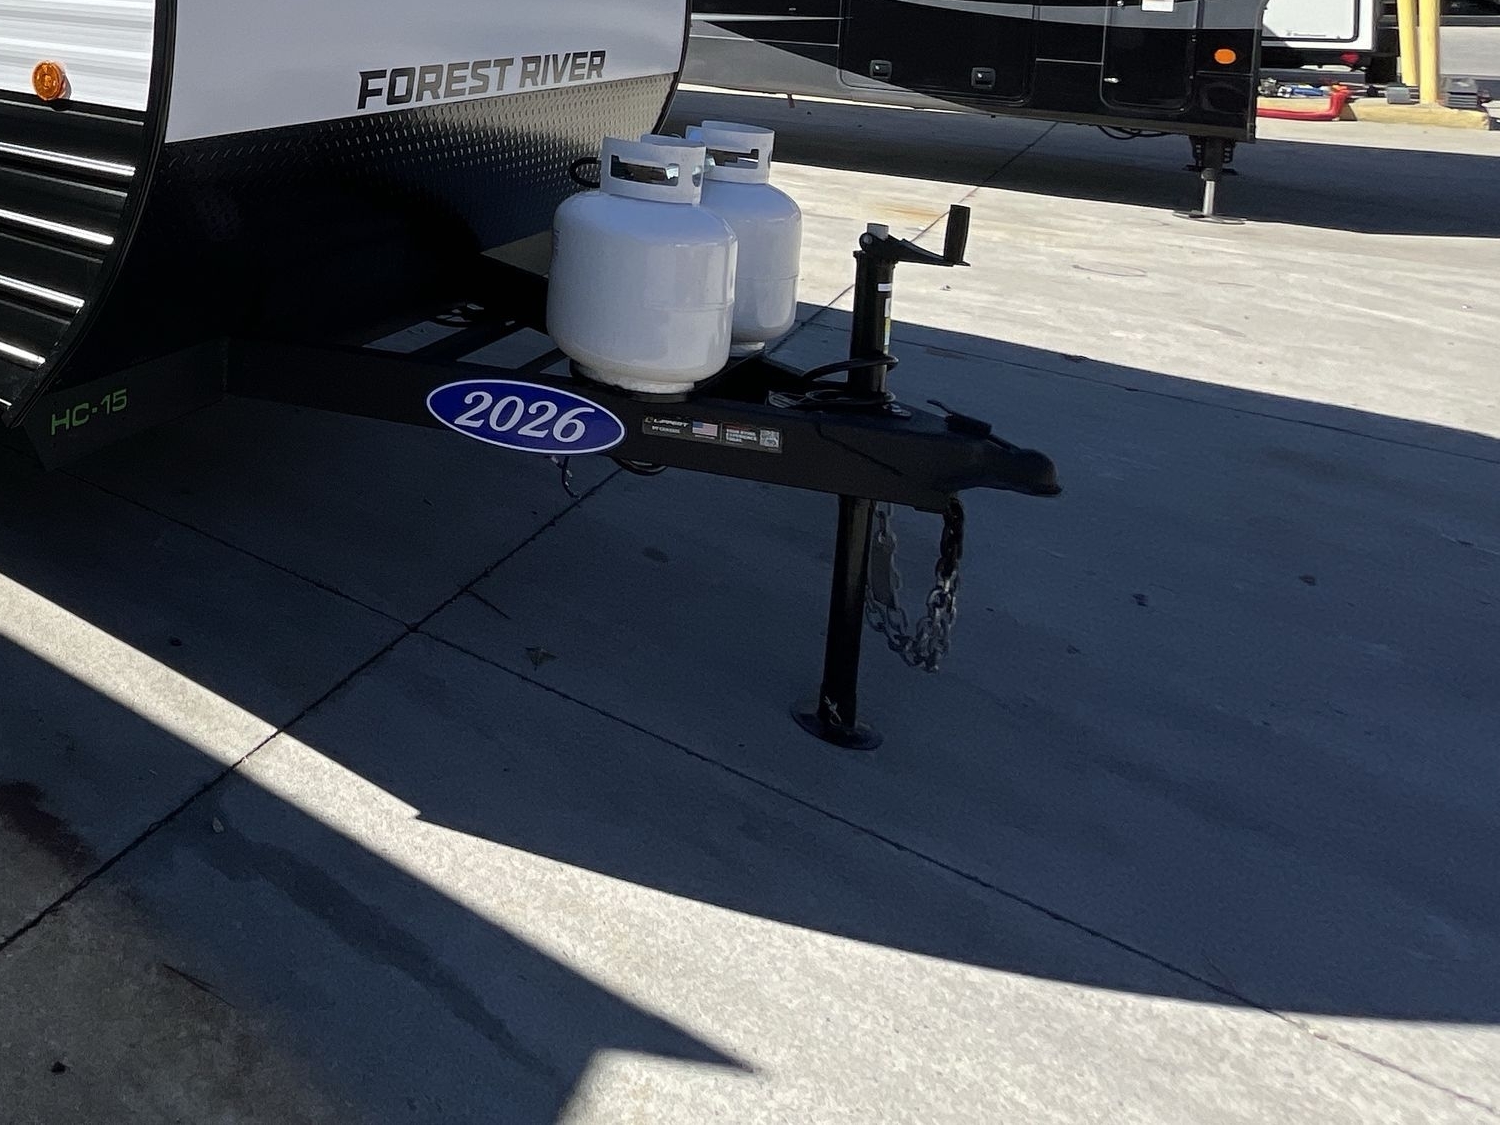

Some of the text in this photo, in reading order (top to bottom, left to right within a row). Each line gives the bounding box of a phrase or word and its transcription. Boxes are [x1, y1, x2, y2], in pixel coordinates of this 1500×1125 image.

[357, 50, 606, 110] FOREST RIVER
[454, 391, 595, 443] 2026
